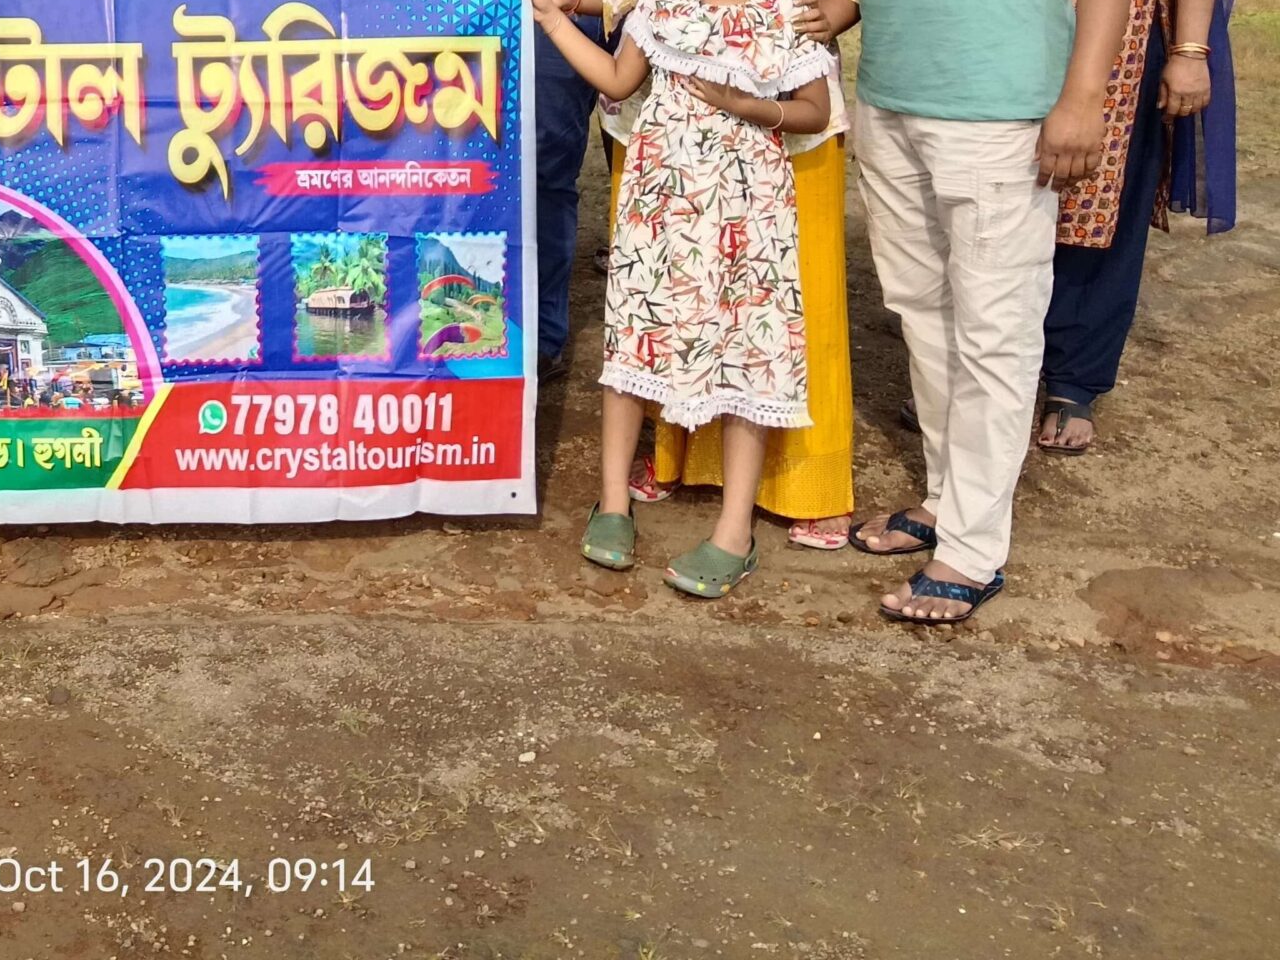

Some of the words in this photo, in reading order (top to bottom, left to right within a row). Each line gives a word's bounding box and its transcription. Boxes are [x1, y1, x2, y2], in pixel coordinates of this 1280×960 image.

[166, 3, 503, 199] ট্যুরিজম
[295, 169, 354, 189] ভ্রমণের
[358, 161, 472, 189] আনন্দনিকেতন
[231, 394, 340, 436] 77978
[353, 392, 454, 436] 40011
[32, 427, 103, 470] হুগলী
[175, 436, 496, 478] www.crystaltourism.in
